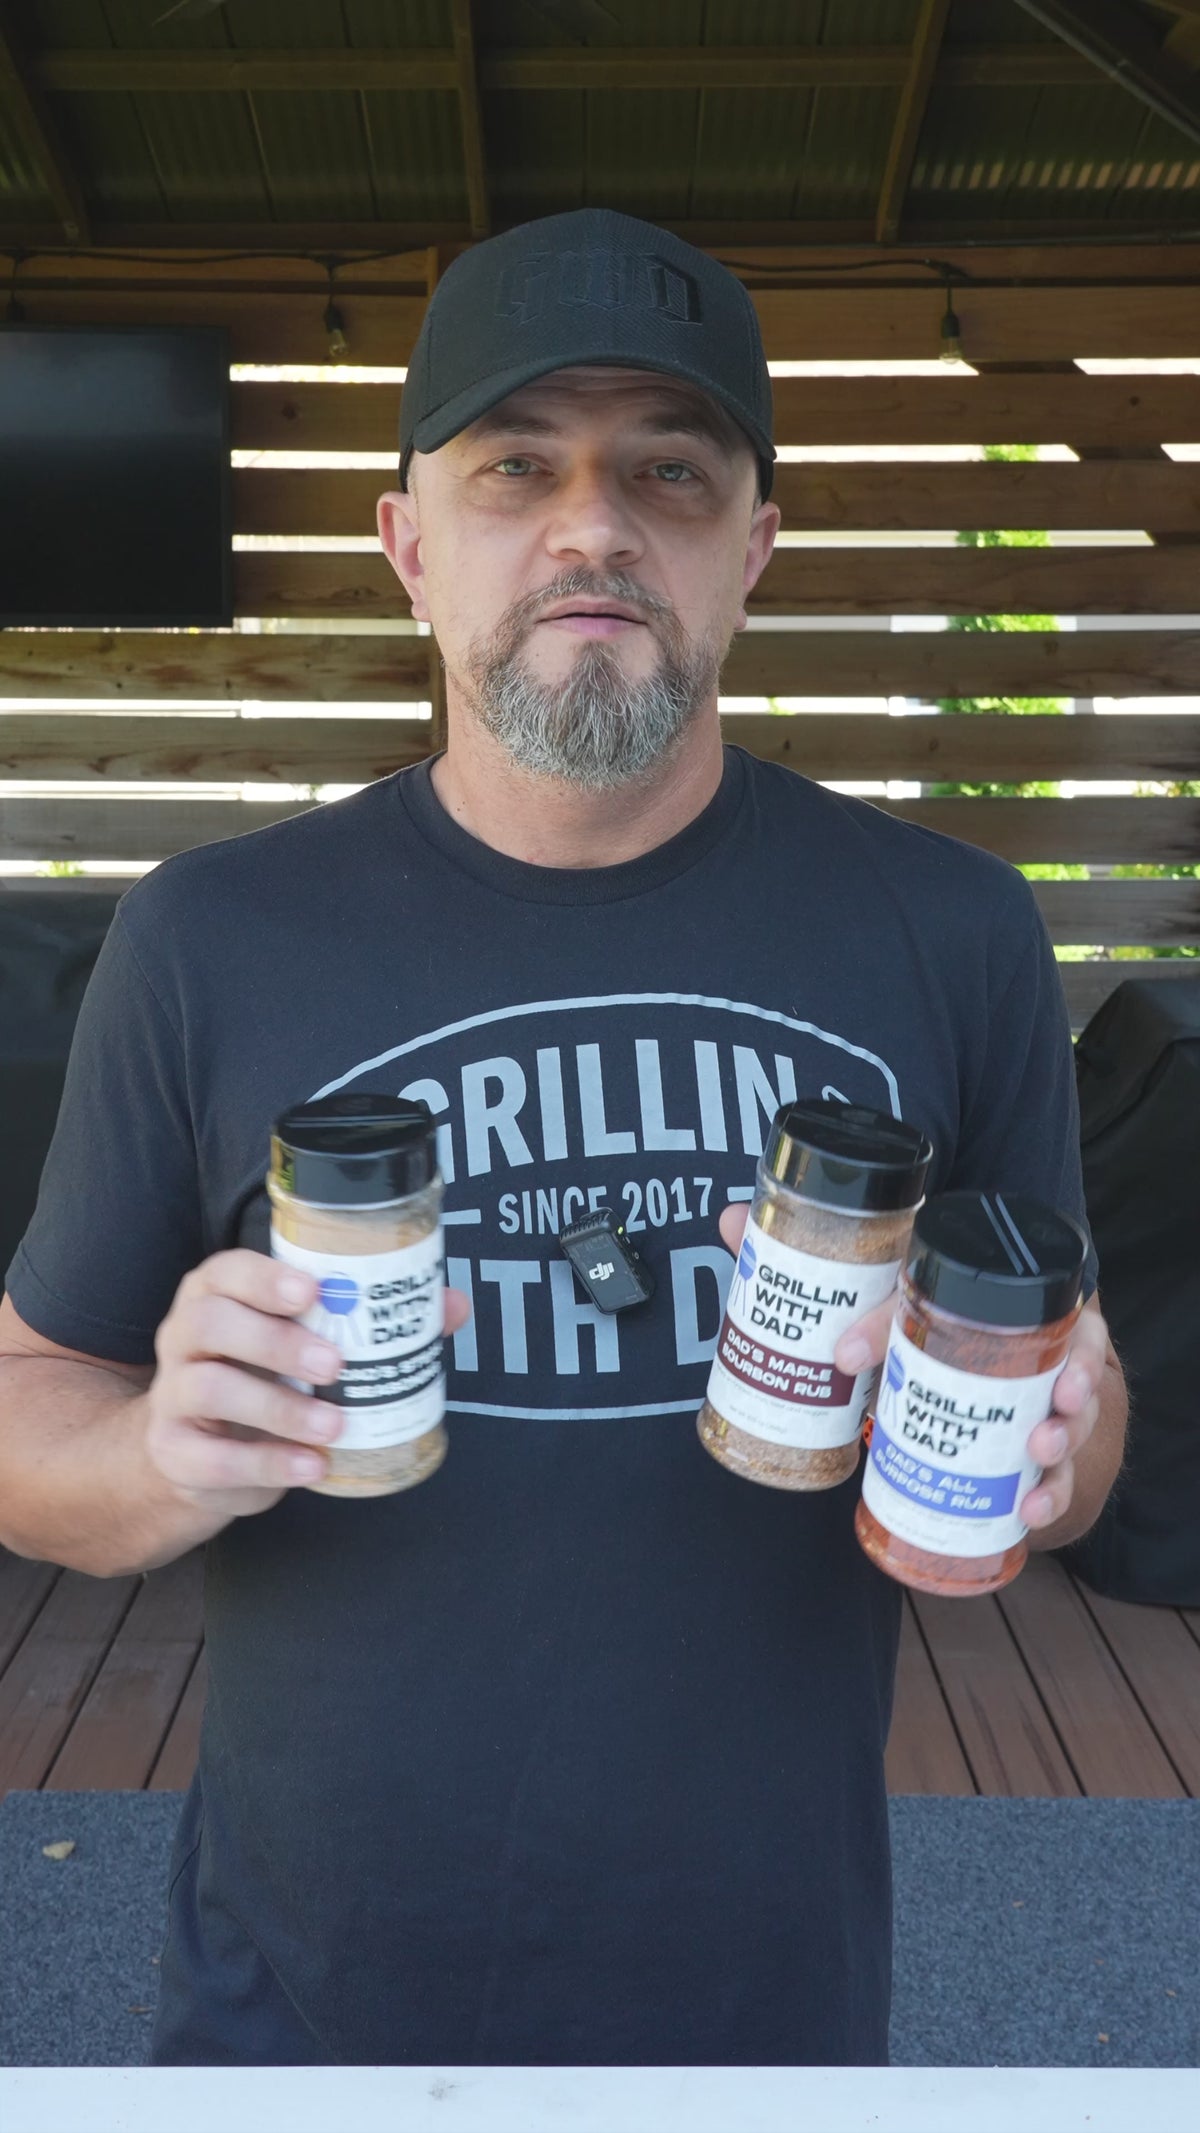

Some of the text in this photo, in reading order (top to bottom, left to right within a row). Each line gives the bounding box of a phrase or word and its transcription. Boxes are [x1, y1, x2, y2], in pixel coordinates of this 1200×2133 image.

[622, 1177, 713, 1232] 2017
[755, 1283, 823, 1325] WITH
[758, 1263, 857, 1307] GRILLIN
[446, 1256, 620, 1374] ITH
[722, 1342, 790, 1392] BOURBON
[793, 1382, 832, 1399] RUB
[727, 1327, 833, 1383] DAD'S MAPLE
[906, 1398, 979, 1442] WITH
[908, 1380, 1016, 1422] GRILLIN
[874, 1448, 947, 1505] PURPOSE
[950, 1494, 993, 1511] RUB
[886, 1443, 978, 1495] DAD'S ALL
